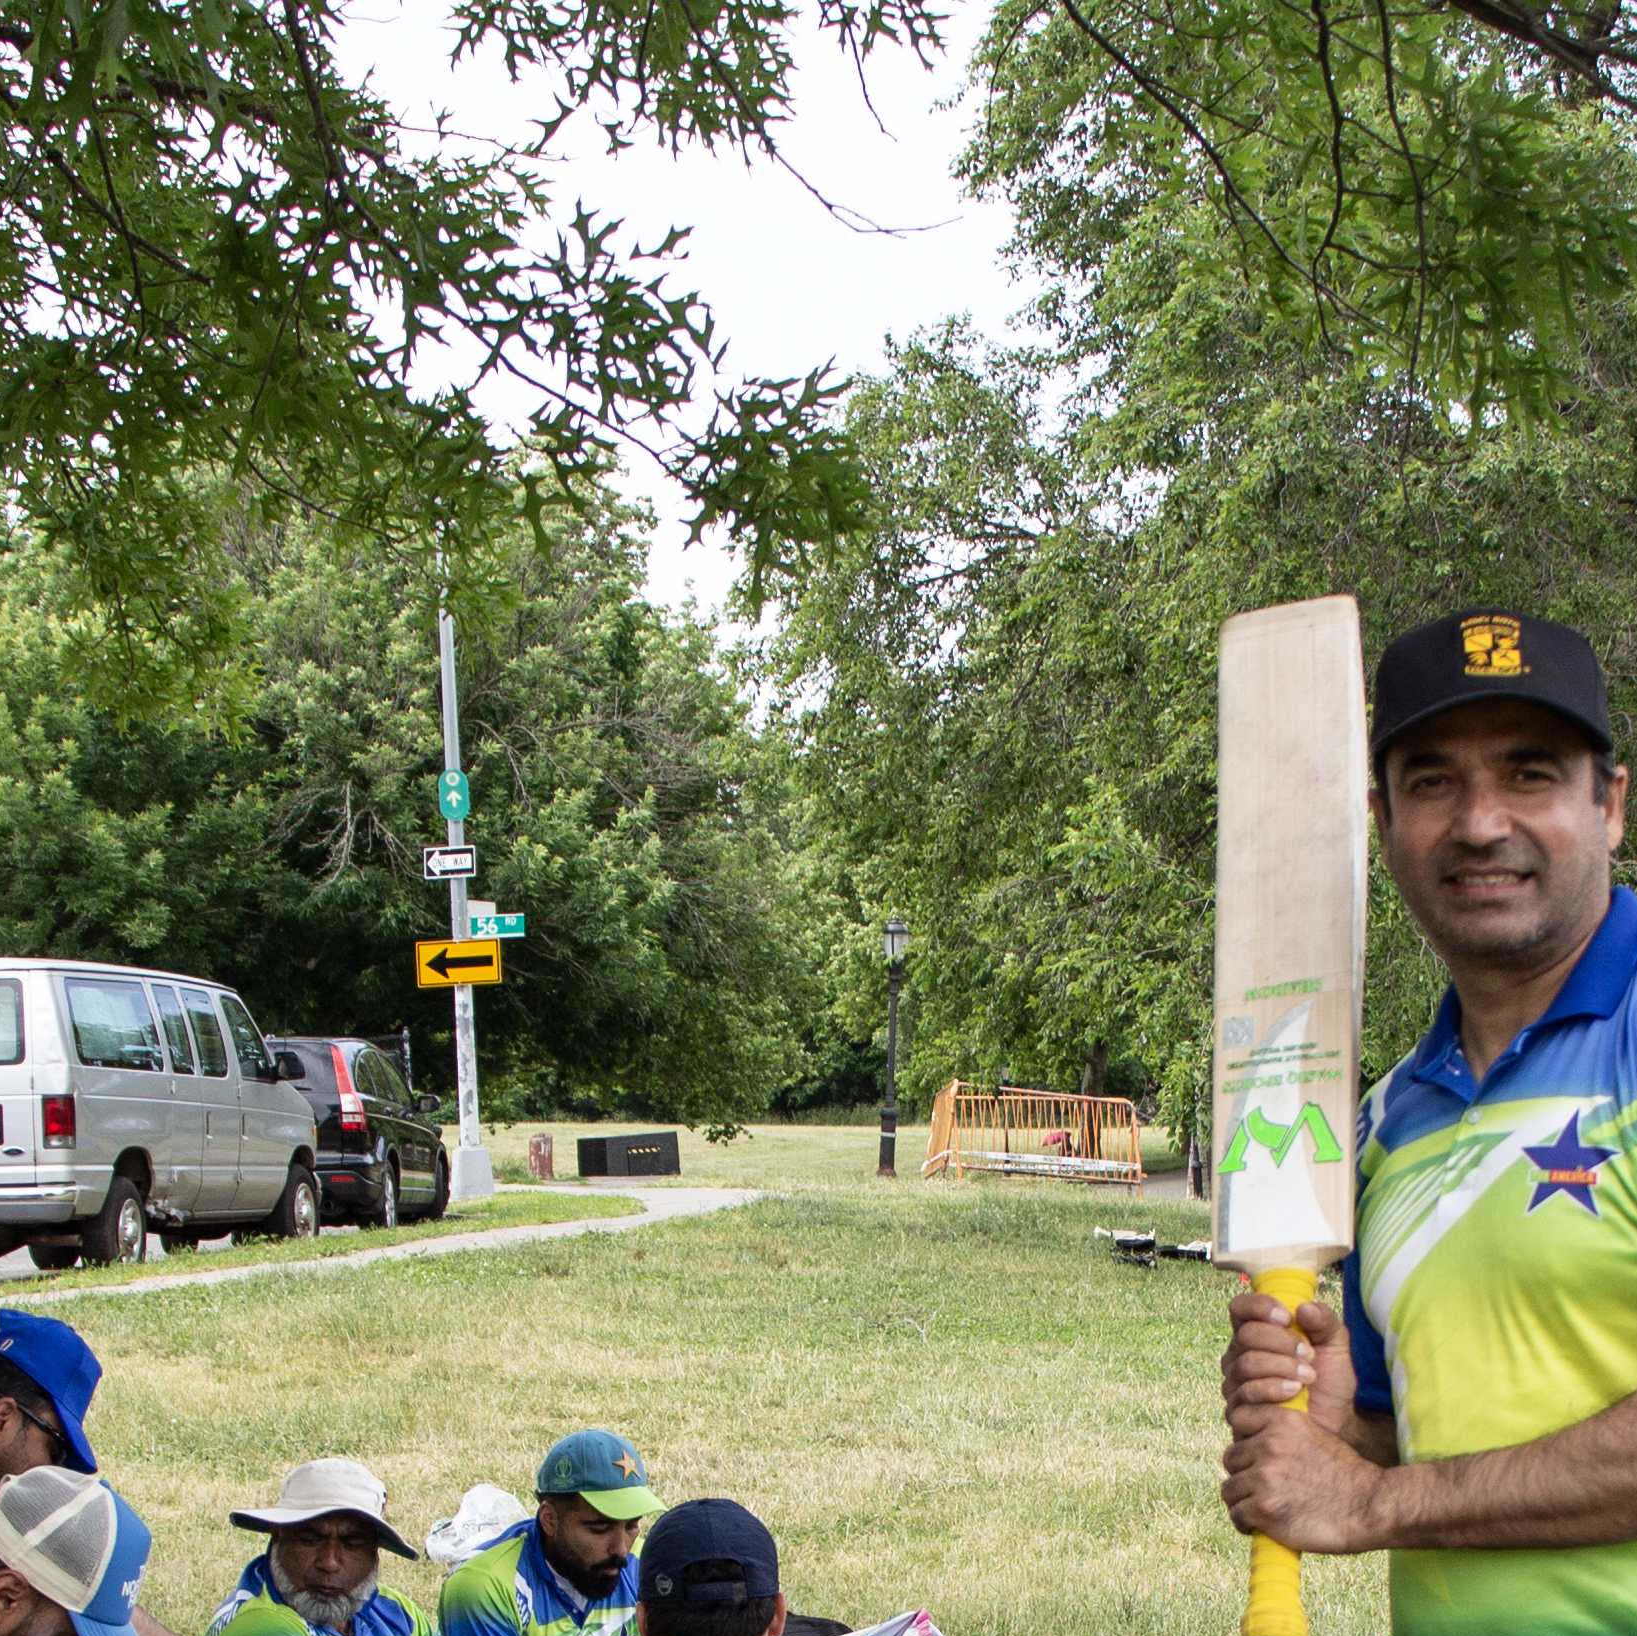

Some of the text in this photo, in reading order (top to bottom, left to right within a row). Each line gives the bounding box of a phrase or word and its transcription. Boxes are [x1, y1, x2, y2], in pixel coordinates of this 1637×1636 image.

[432, 856, 469, 869] ONE WAY
[476, 917, 517, 936] 56 RD
[1245, 978, 1324, 1001] SHADOW
[1221, 1072, 1284, 1094] SPORTS
